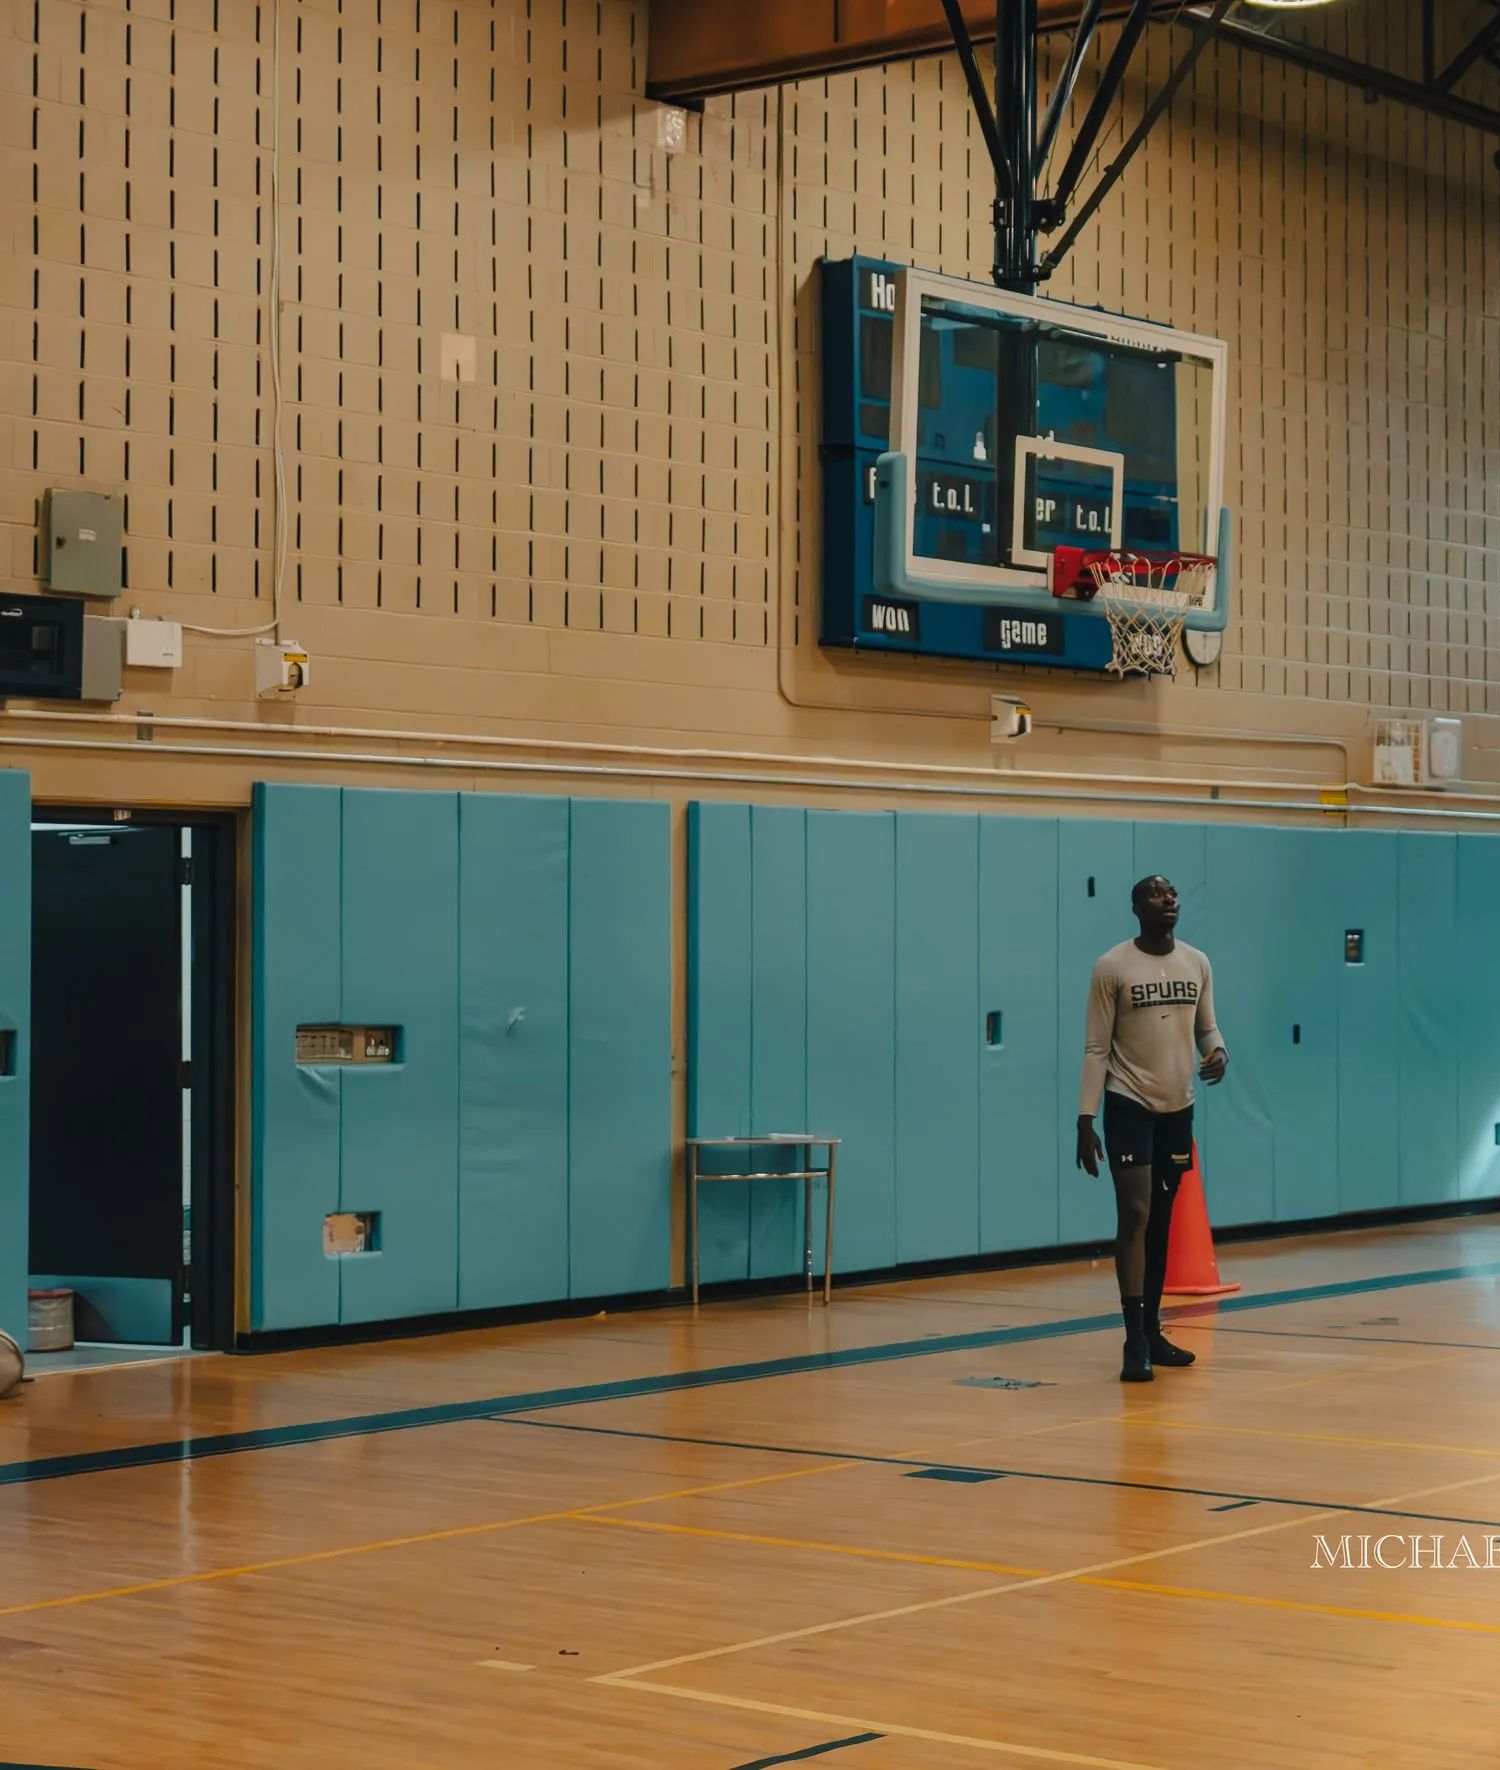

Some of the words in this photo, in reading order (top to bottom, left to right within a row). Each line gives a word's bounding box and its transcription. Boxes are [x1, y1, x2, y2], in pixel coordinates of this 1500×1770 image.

[872, 604, 910, 632] won
[1000, 619, 1047, 649] game
[1131, 980, 1198, 1001] SPURS
